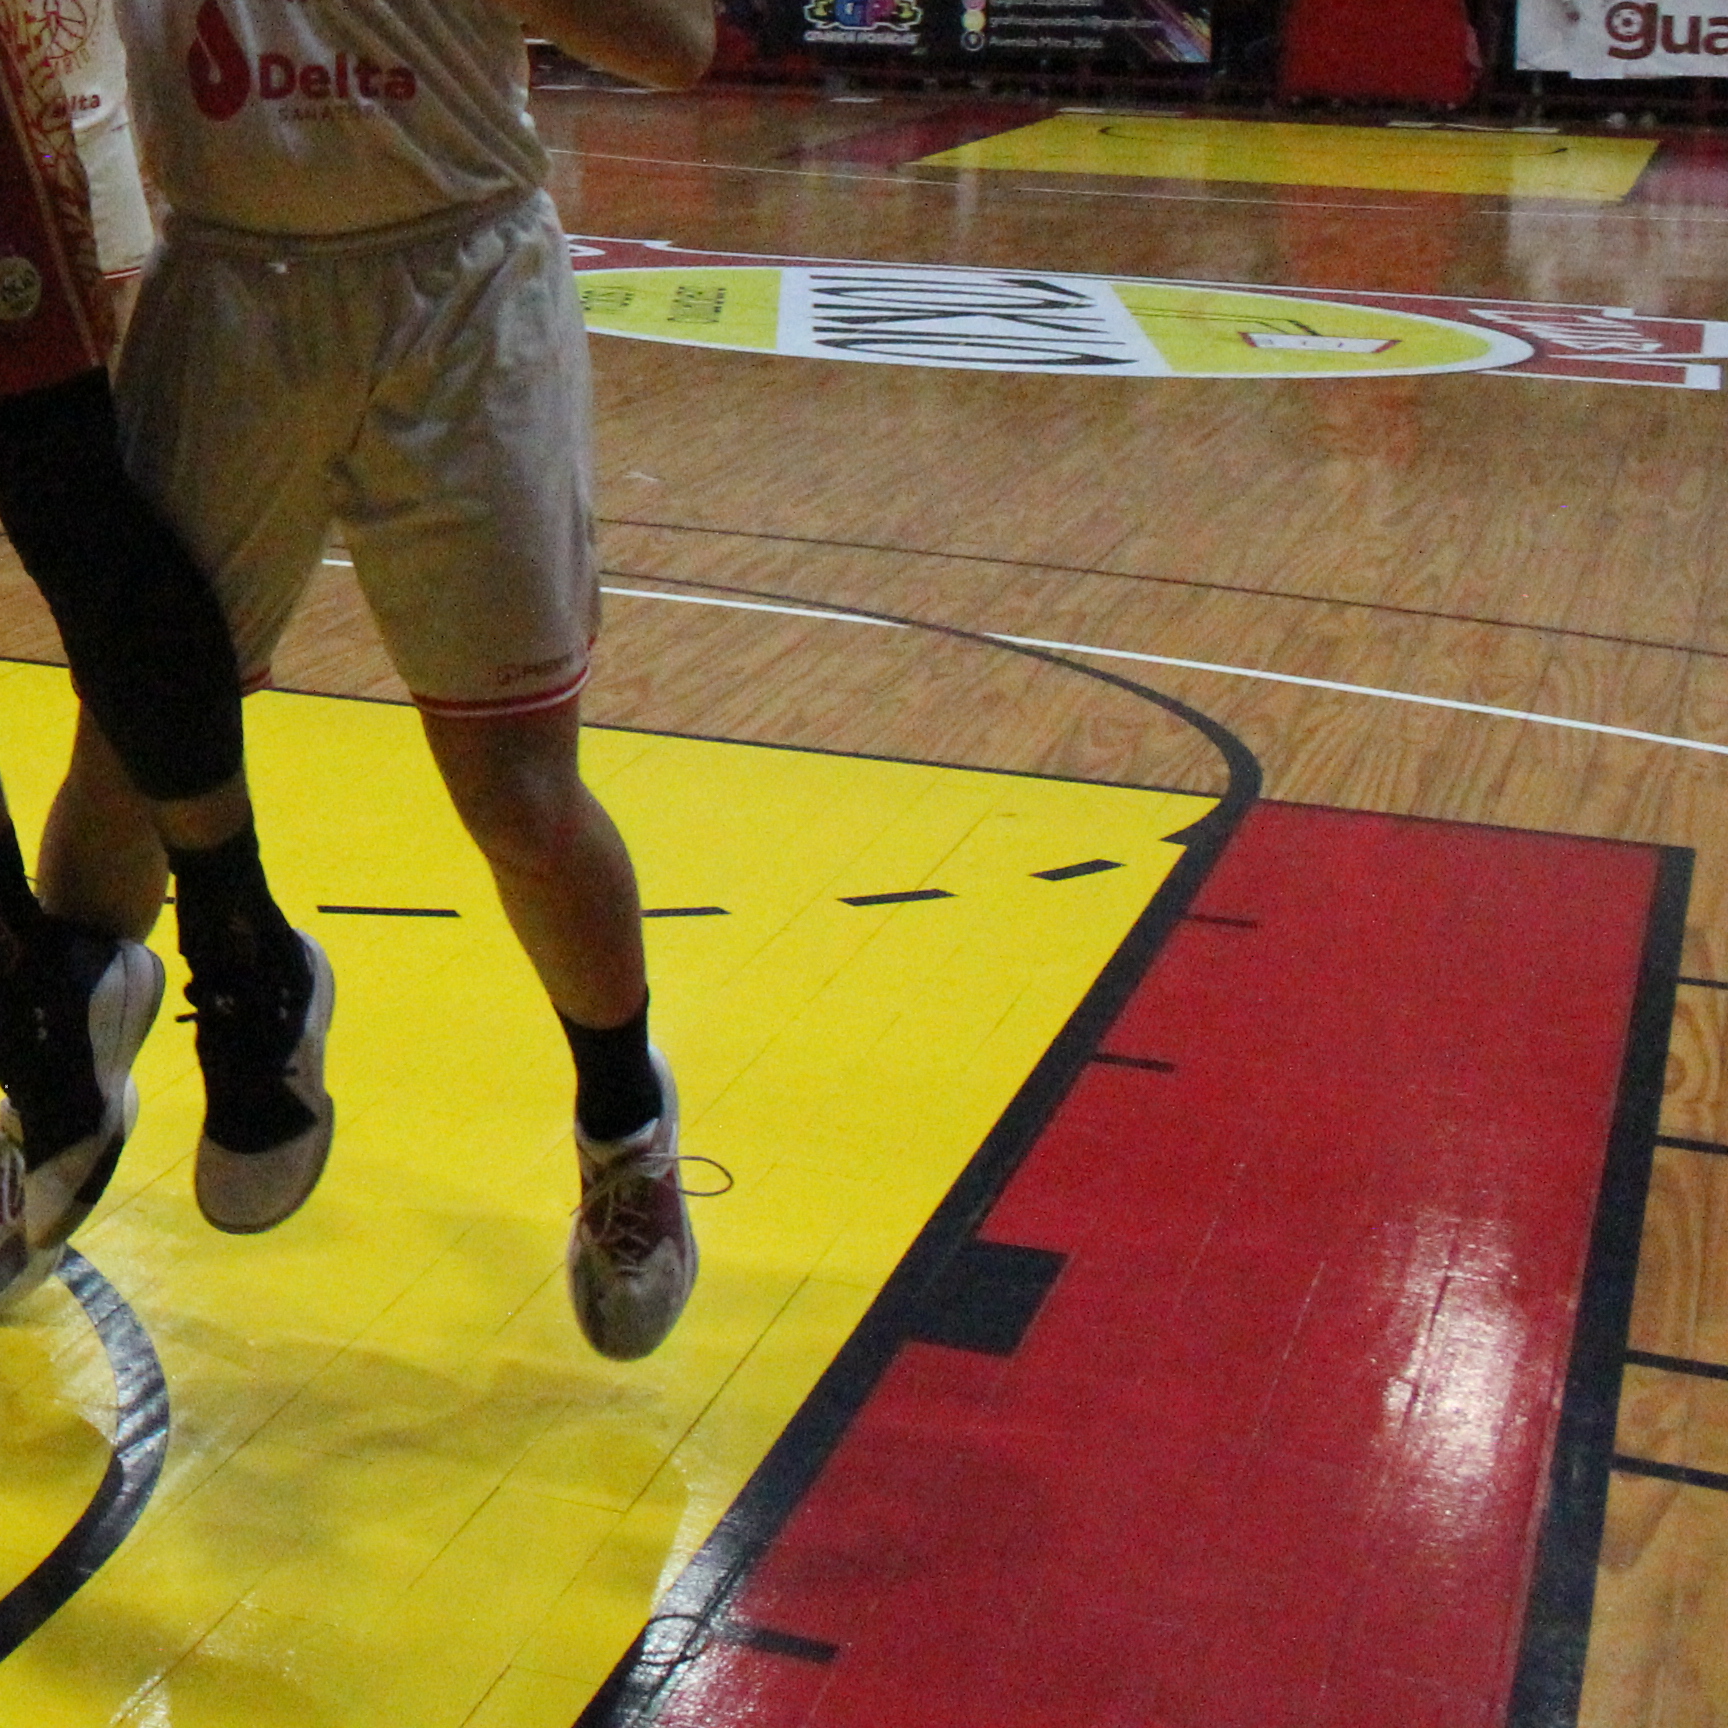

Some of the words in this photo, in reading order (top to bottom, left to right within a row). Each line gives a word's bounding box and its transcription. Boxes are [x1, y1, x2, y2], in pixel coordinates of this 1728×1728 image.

[259, 53, 417, 101] Delta
[809, 274, 1140, 366] TOKIO
[1467, 307, 1664, 354] CLUB
